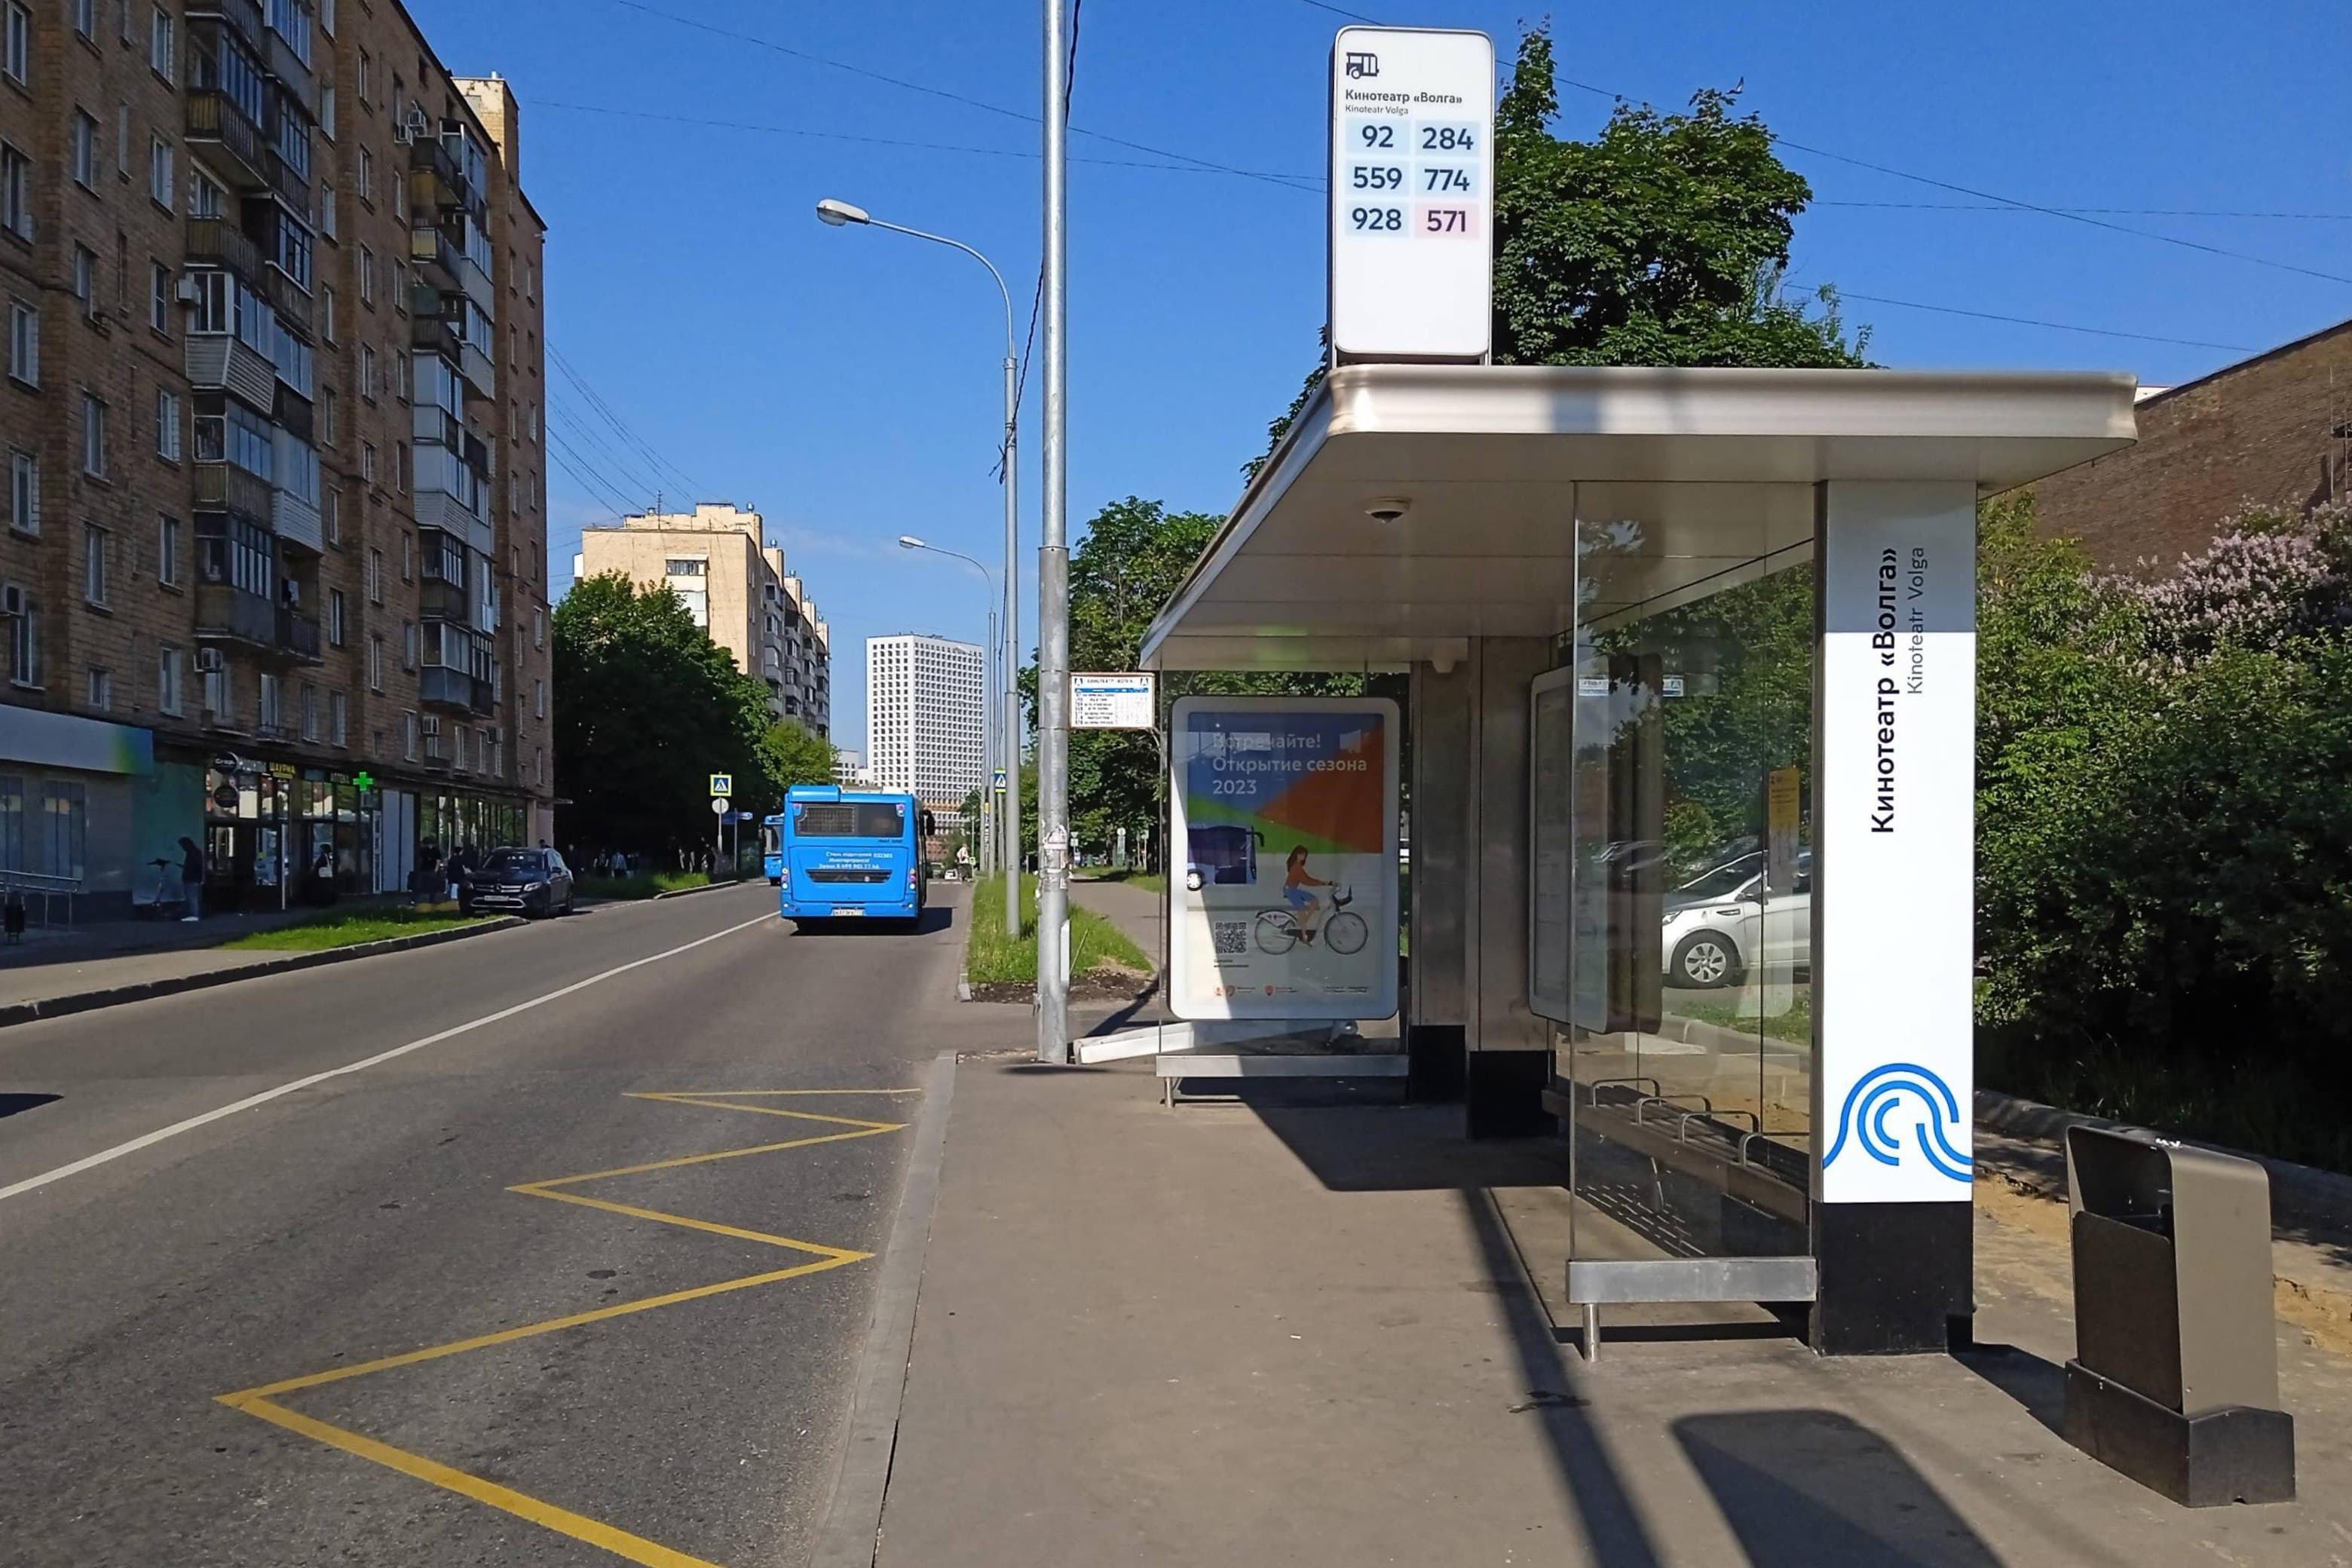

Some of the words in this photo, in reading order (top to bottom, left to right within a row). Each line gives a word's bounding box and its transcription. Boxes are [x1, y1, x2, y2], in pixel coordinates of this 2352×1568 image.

[1345, 89, 1410, 103] Кинотеатр
[1413, 92, 1462, 104] «Волга»
[1345, 105, 1383, 115] Kinoteatr
[1385, 106, 1409, 116] Volga
[1361, 125, 1394, 149] 92
[1421, 127, 1474, 151] 284
[1353, 167, 1403, 190] 559
[1424, 168, 1470, 191] 774
[1351, 207, 1402, 231] 928
[1426, 210, 1466, 232] 571
[1906, 547, 1928, 601] Volga
[1872, 547, 1898, 667] «Волга»
[1906, 608, 1924, 694] Kinoteatr
[1212, 756, 1302, 776] Открытие
[1306, 759, 1367, 772] сезона
[1870, 677, 1900, 833] Кинотеатр
[1212, 779, 1257, 795] 2023
